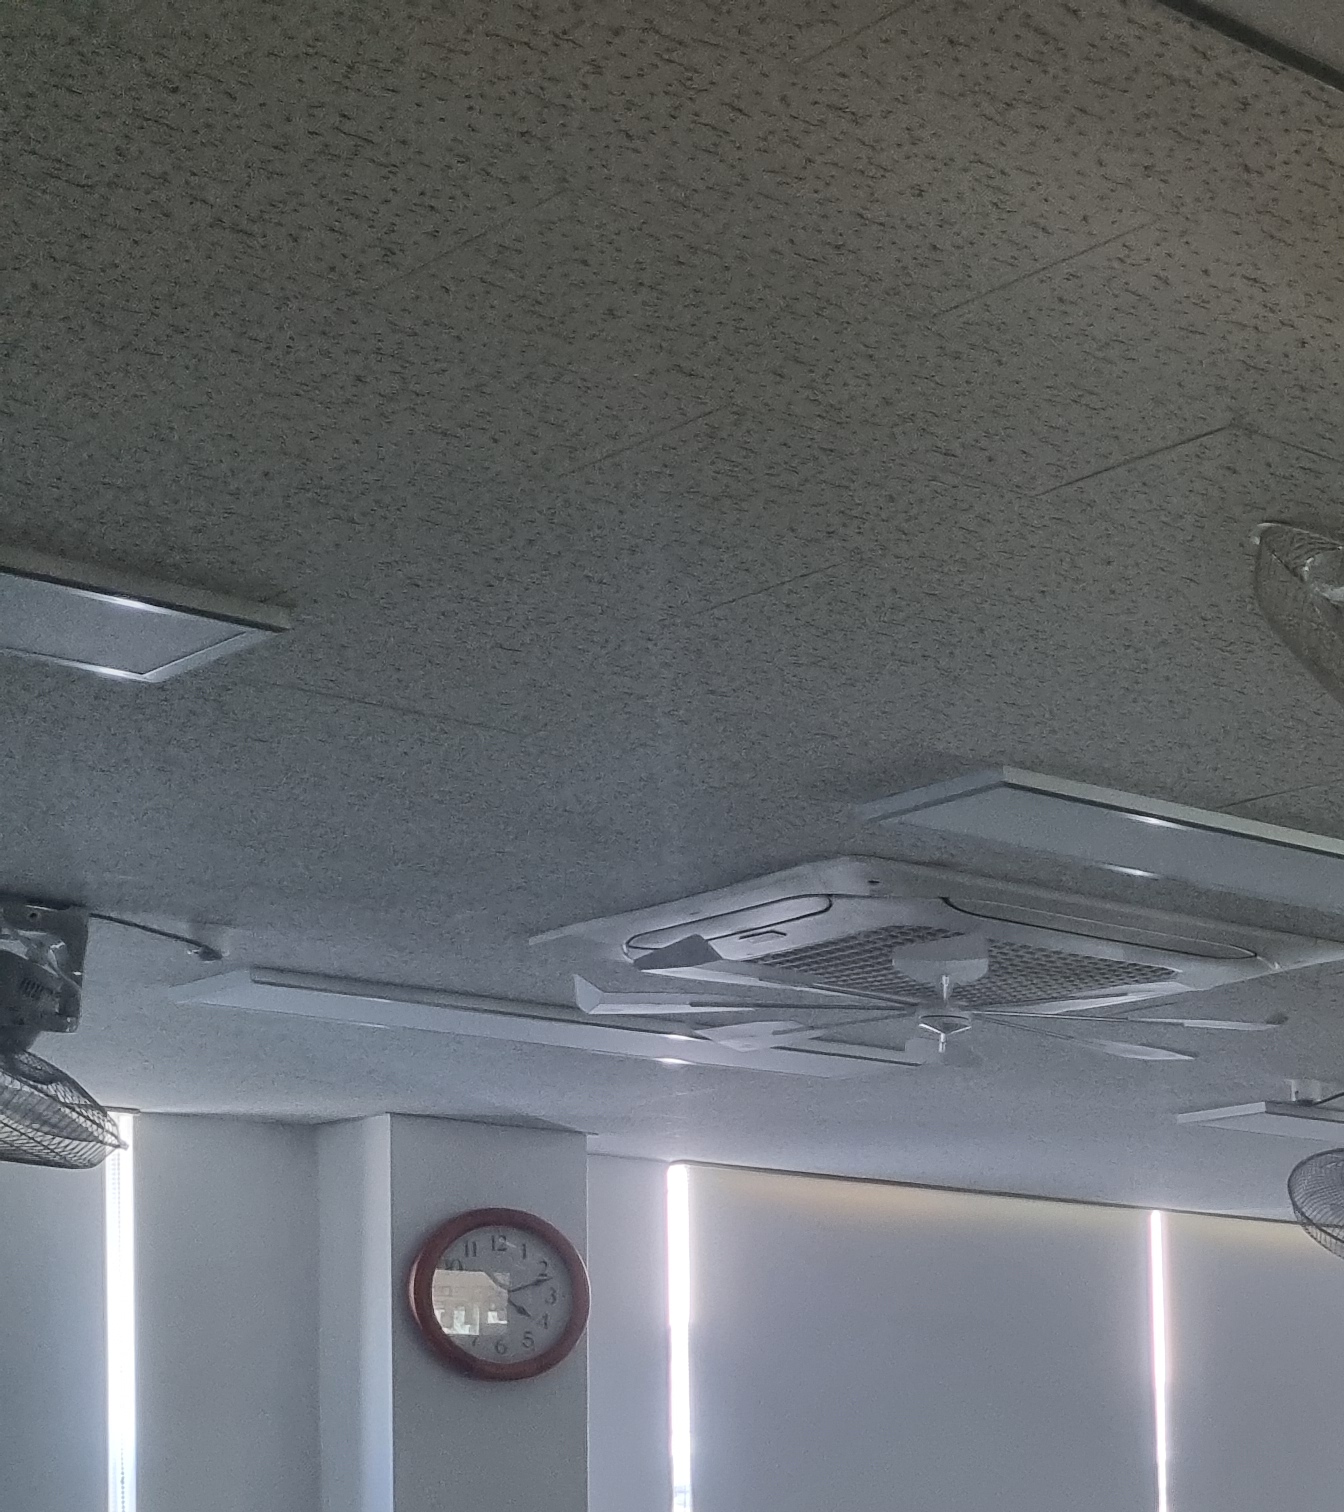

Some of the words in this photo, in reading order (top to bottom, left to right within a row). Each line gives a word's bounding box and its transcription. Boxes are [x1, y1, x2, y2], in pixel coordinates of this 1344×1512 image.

[465, 1241, 477, 1257] 11
[491, 1235, 507, 1251] 12
[521, 1244, 528, 1259] 1
[537, 1261, 548, 1278] 2
[545, 1288, 556, 1304] 3
[495, 1339, 507, 1354] 6
[522, 1332, 534, 1348] 5
